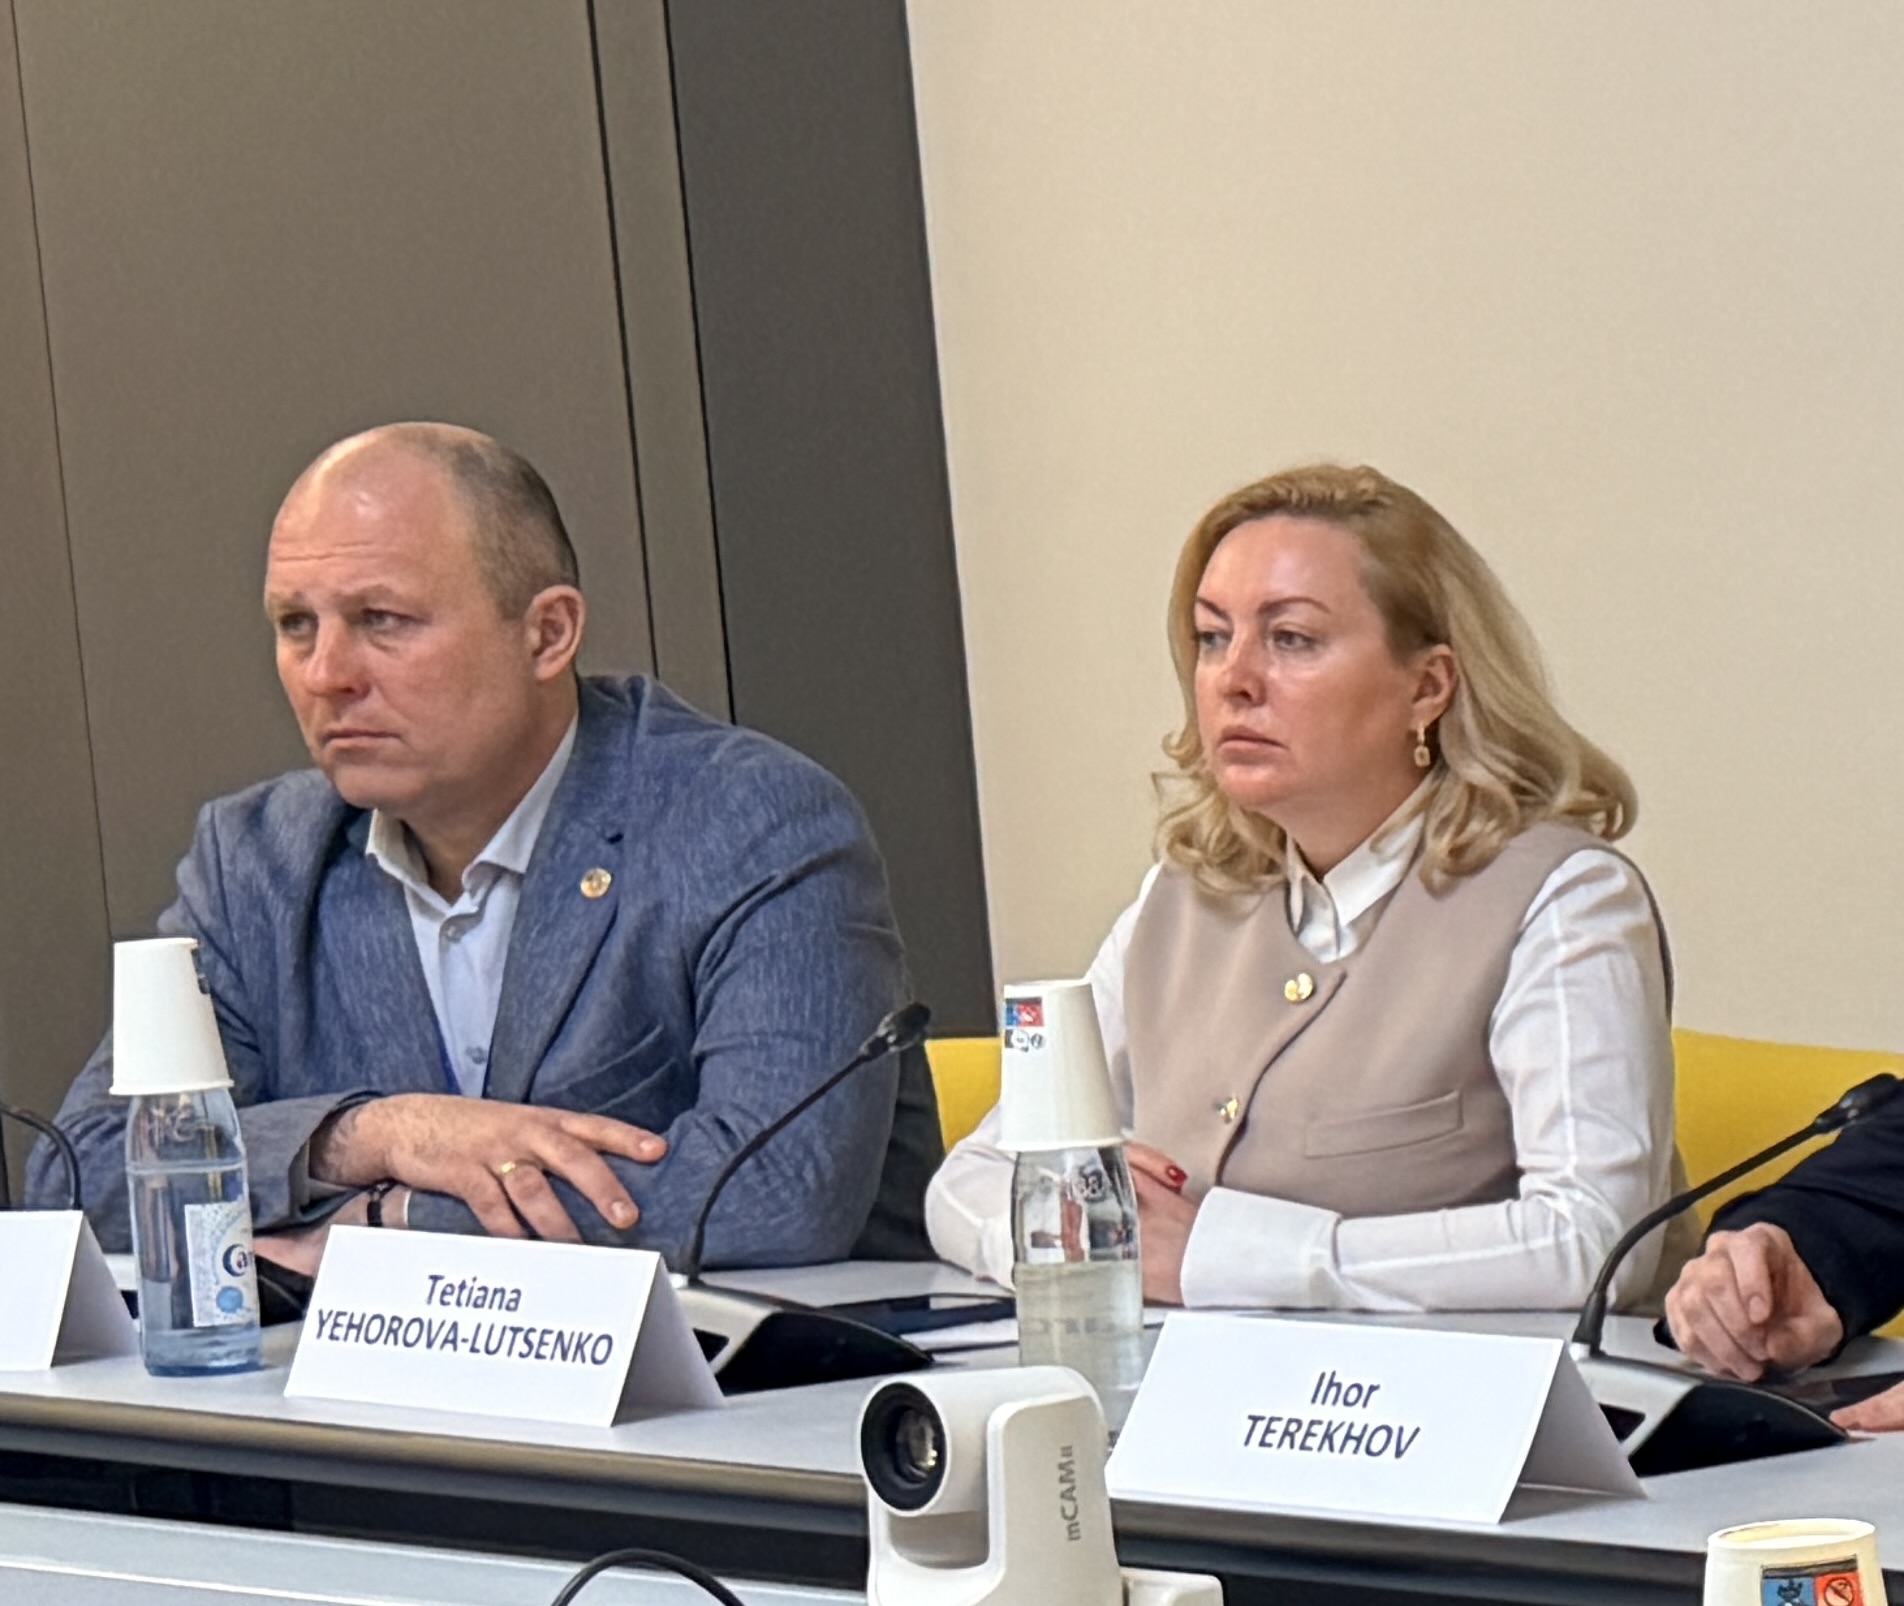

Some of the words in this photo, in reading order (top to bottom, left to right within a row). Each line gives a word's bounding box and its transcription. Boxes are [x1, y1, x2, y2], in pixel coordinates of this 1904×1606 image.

[425, 1274, 522, 1312] Tetiana
[316, 1309, 613, 1366] YEHOROVA-LUTSENKO
[1310, 1370, 1380, 1409] Ihor
[1243, 1414, 1421, 1459] TEREKHOV
